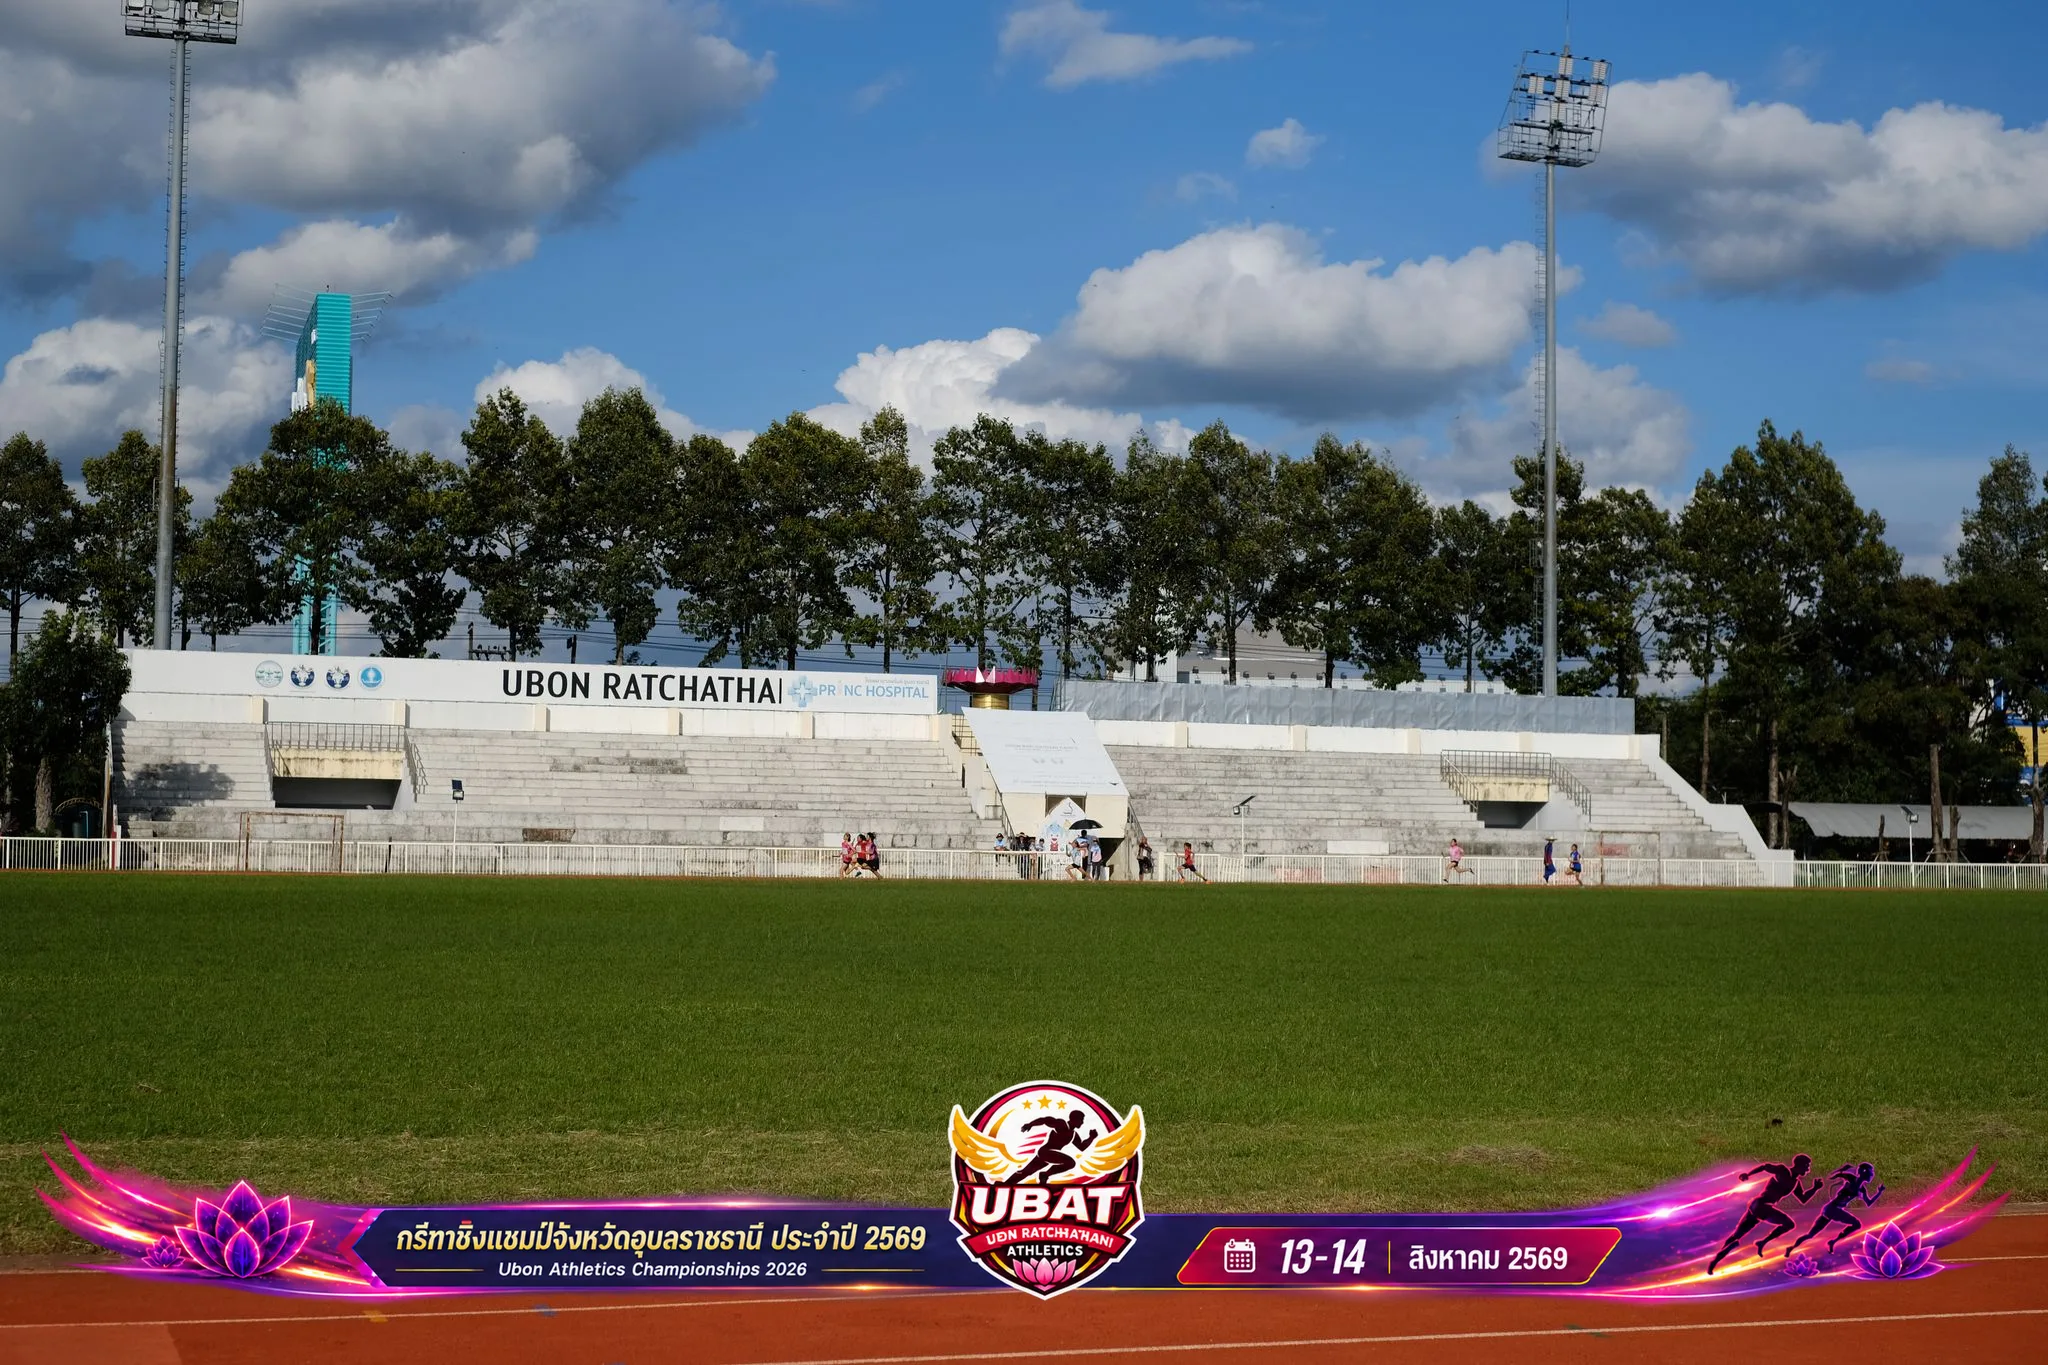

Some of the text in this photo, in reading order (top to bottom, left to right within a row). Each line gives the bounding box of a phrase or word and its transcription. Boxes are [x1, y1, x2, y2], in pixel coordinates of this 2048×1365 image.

[502, 669, 782, 705] UBON RATCHATHA
[866, 685, 929, 699] HOSPITAL
